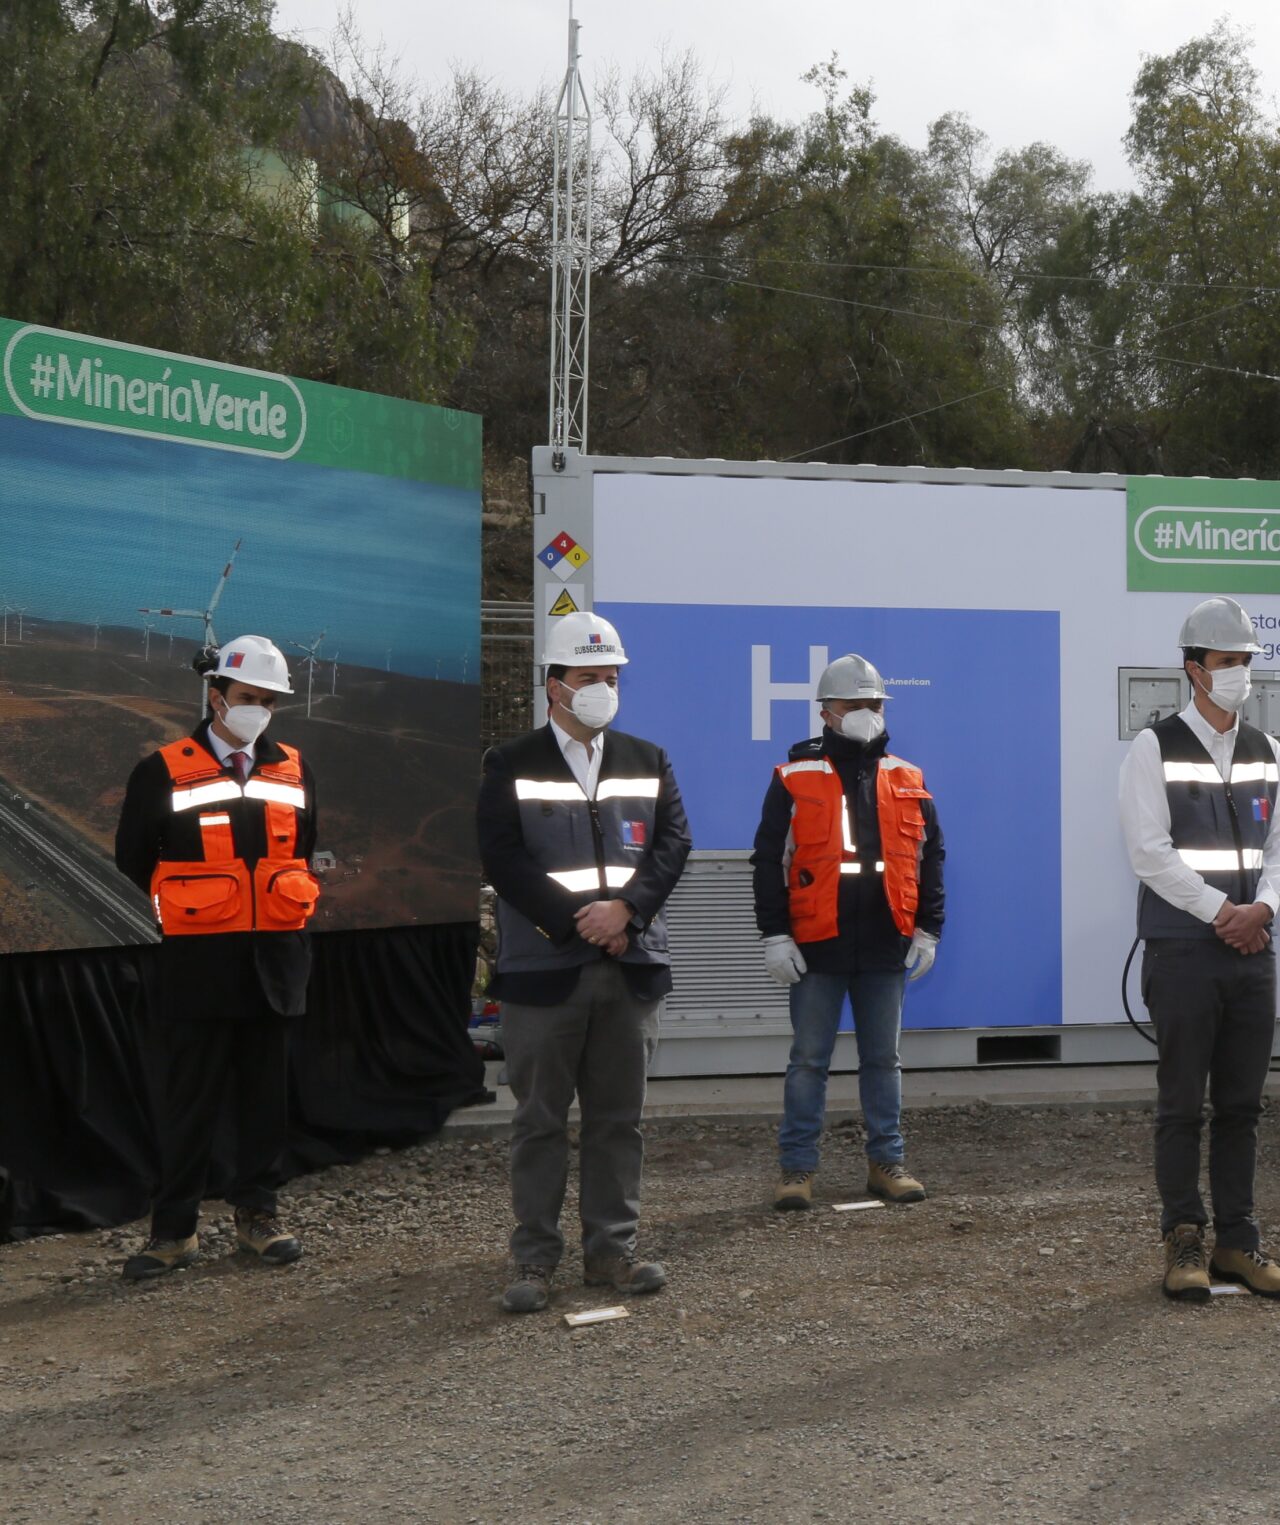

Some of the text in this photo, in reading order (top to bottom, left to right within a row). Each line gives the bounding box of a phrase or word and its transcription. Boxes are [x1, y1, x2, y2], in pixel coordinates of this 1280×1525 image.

[30, 352, 288, 440] #MineríaVerde
[560, 540, 567, 548] 4
[574, 553, 580, 561] 0
